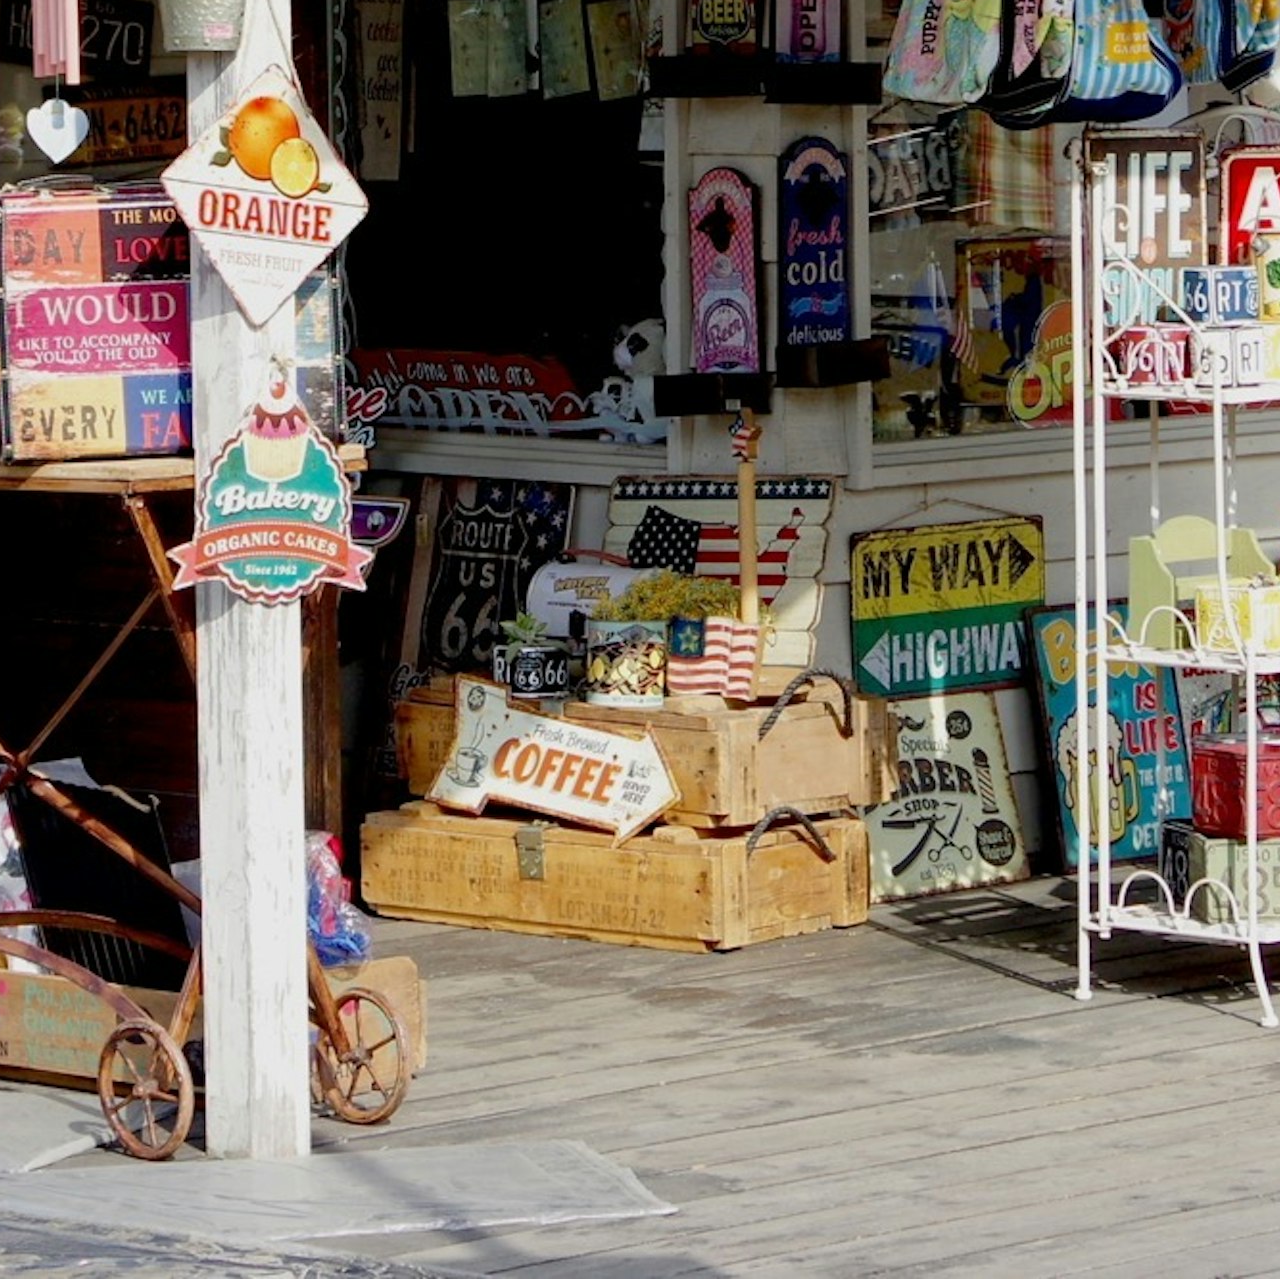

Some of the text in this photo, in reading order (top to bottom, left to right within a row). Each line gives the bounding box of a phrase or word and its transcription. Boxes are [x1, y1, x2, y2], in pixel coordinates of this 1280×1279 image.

[80, 16, 145, 65] 270
[112, 208, 143, 226] THE
[197, 189, 333, 243] ORANGE
[1103, 151, 1194, 260] LIFE
[13, 227, 87, 267] DAY
[115, 235, 190, 263] LOVE
[786, 216, 846, 257] fresh
[219, 248, 304, 273] FRESH FRUIT
[785, 247, 846, 287] cold
[39, 291, 177, 327] WOULD
[18, 331, 172, 352] LIKE TO ACCOMPANY
[786, 323, 846, 346] delicious
[35, 346, 158, 364] YOU TO THE OLD
[406, 359, 536, 387] come in we are
[141, 389, 169, 405] WE
[214, 481, 338, 523] Bakery
[202, 530, 338, 558] ORGANIC CAKES
[449, 519, 514, 553] ROUTE
[244, 563, 270, 576] Since
[860, 538, 1008, 600] MY WAY
[439, 591, 499, 662] 66
[544, 660, 569, 686] 66
[1134, 680, 1157, 711] IS
[532, 723, 611, 755] Fresh Brewed
[491, 736, 624, 806] COFFEE
[903, 798, 940, 817] SHOP
